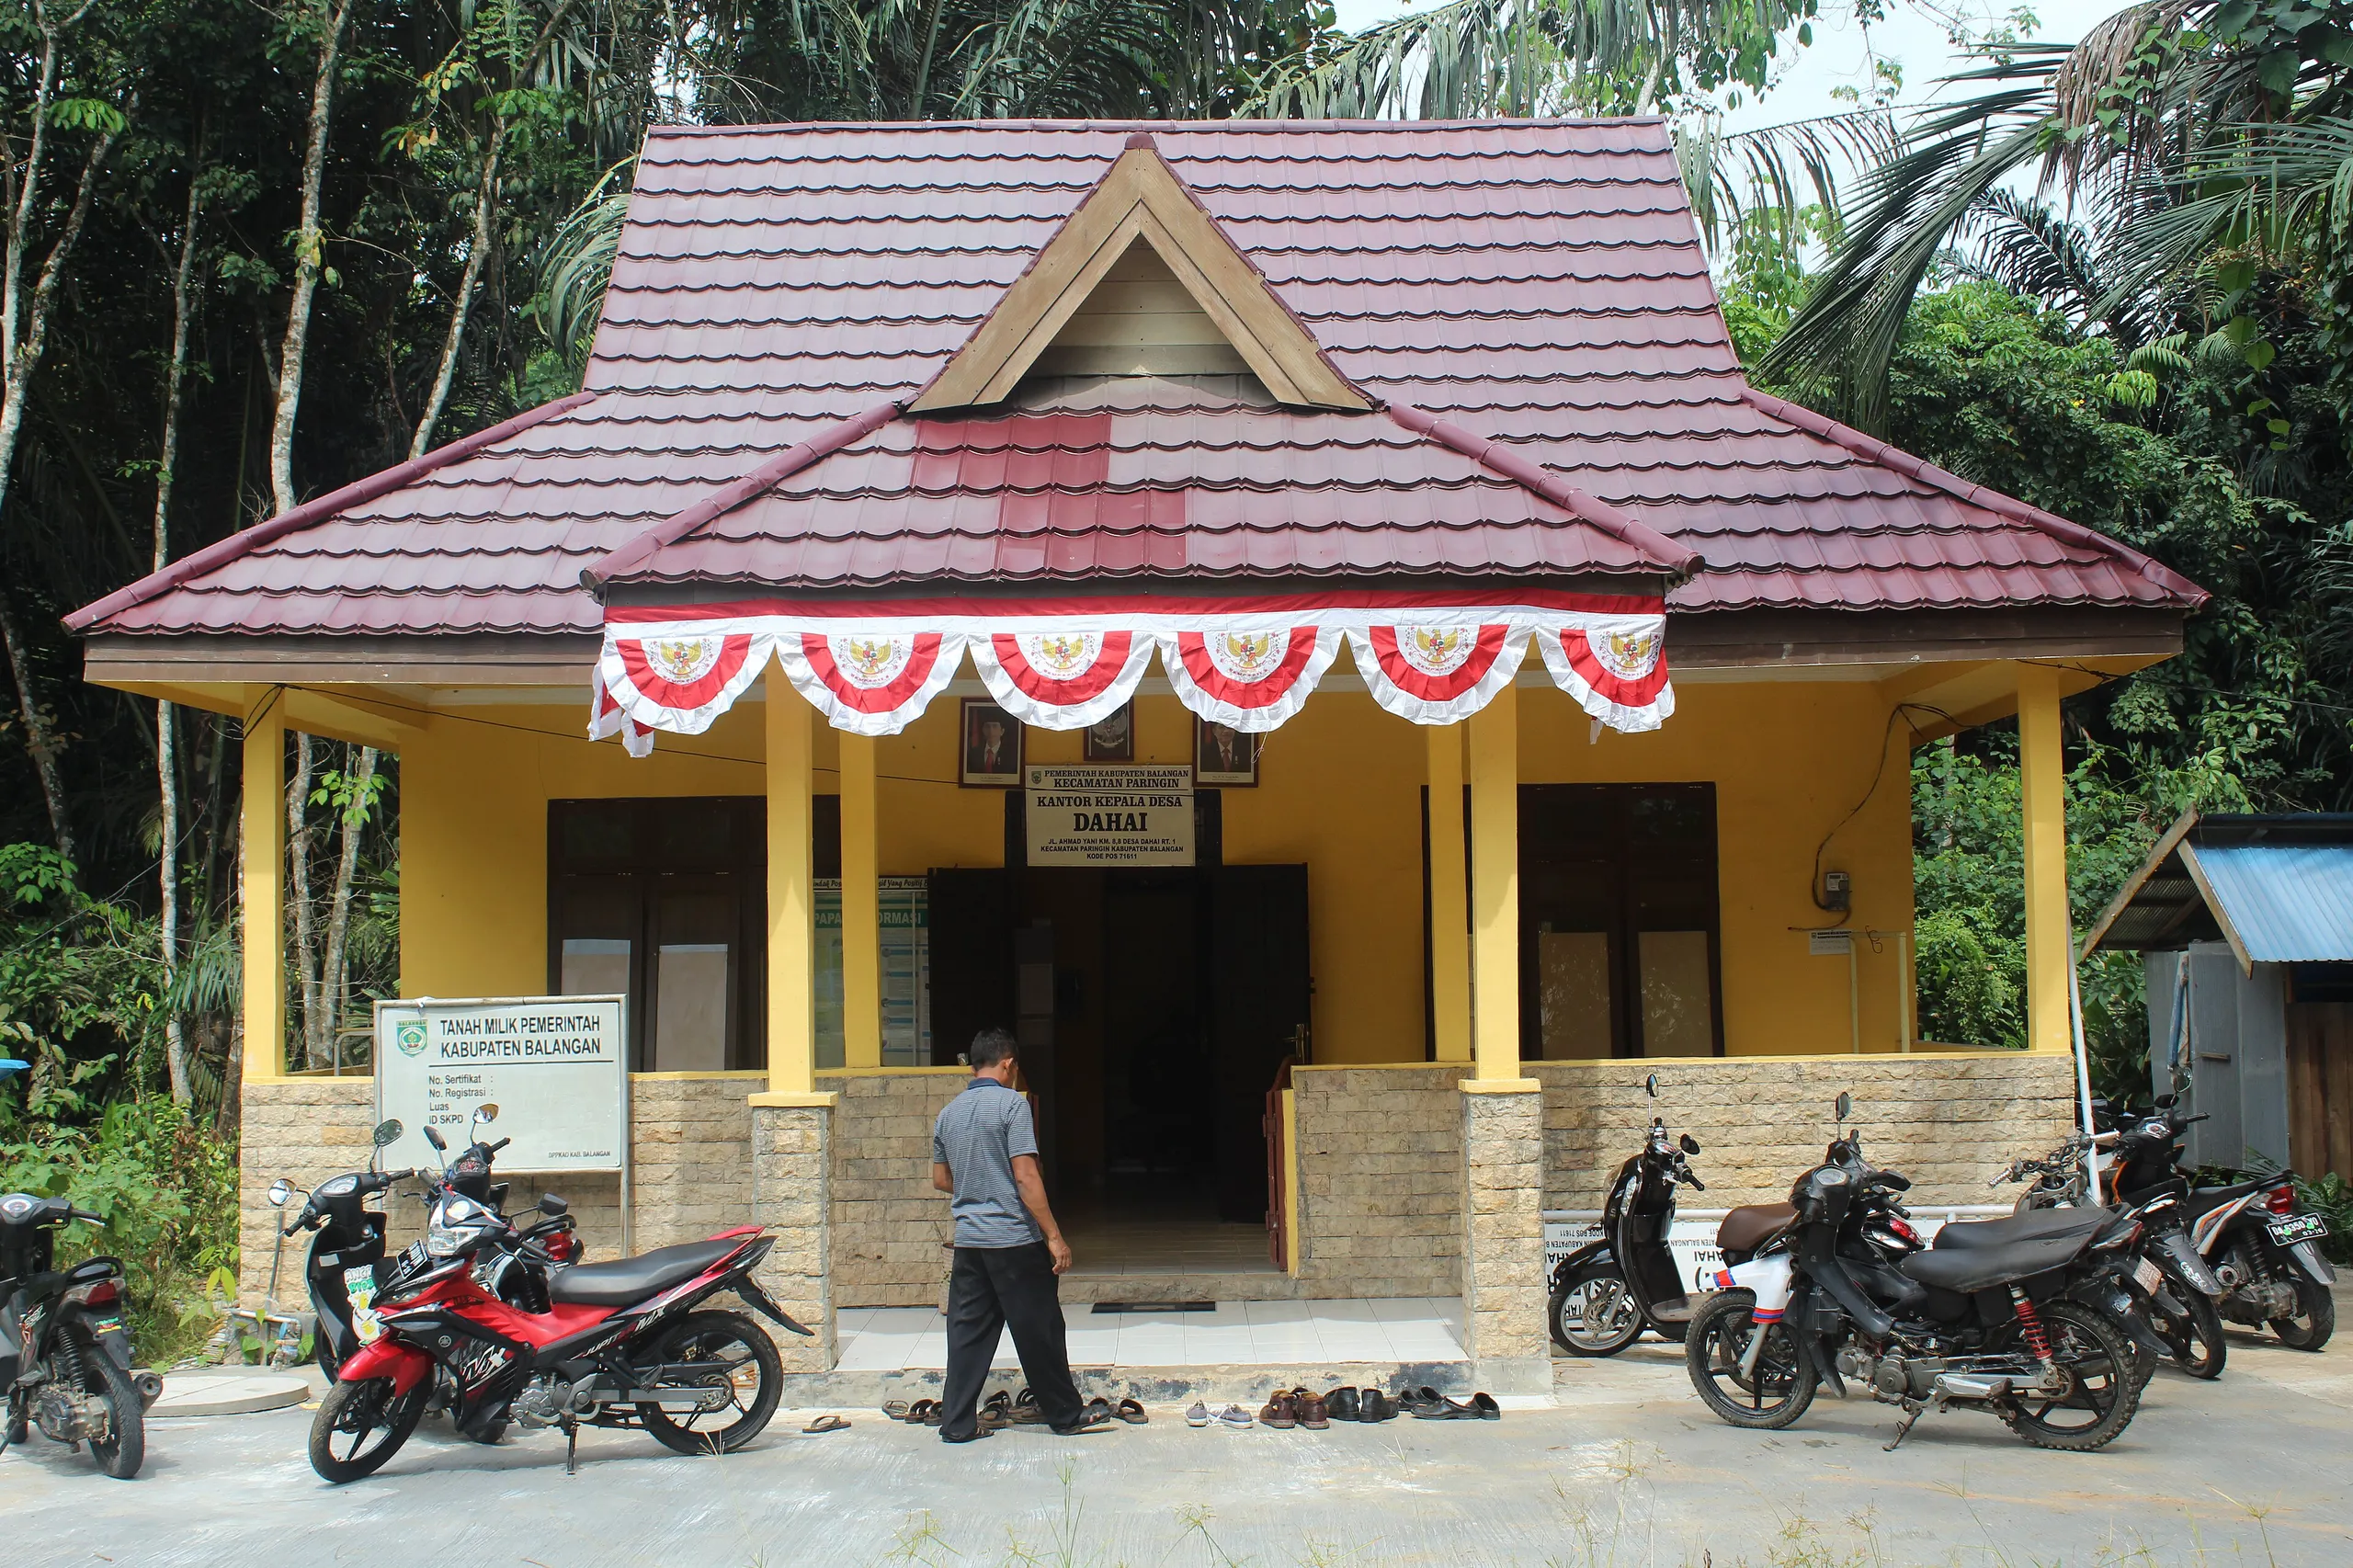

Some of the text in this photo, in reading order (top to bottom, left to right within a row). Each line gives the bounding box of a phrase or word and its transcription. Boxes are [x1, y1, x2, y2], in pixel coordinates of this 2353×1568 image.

[1053, 778, 1179, 788] KECAMATAN PARINGIN
[1037, 796, 1182, 807] KANTOR KEPALA DESA
[1074, 812, 1147, 831] DAHAI
[815, 912, 921, 925] PAPA ORMASI
[440, 1016, 600, 1036] TANAH MILIK PEMERINTAH
[441, 1038, 601, 1058] KABUPATEN BALANGAN
[428, 1075, 443, 1085] No.
[445, 1074, 482, 1085] Sertifikat
[428, 1088, 443, 1098] No.
[445, 1087, 486, 1099] Registrasi
[429, 1102, 449, 1111] Luas
[428, 1114, 463, 1125] ID SKPD
[1588, 1229, 1604, 1237] KODE
[1551, 1240, 1584, 1248] KABUPATEN
[1694, 1251, 1723, 1262] AHAI
